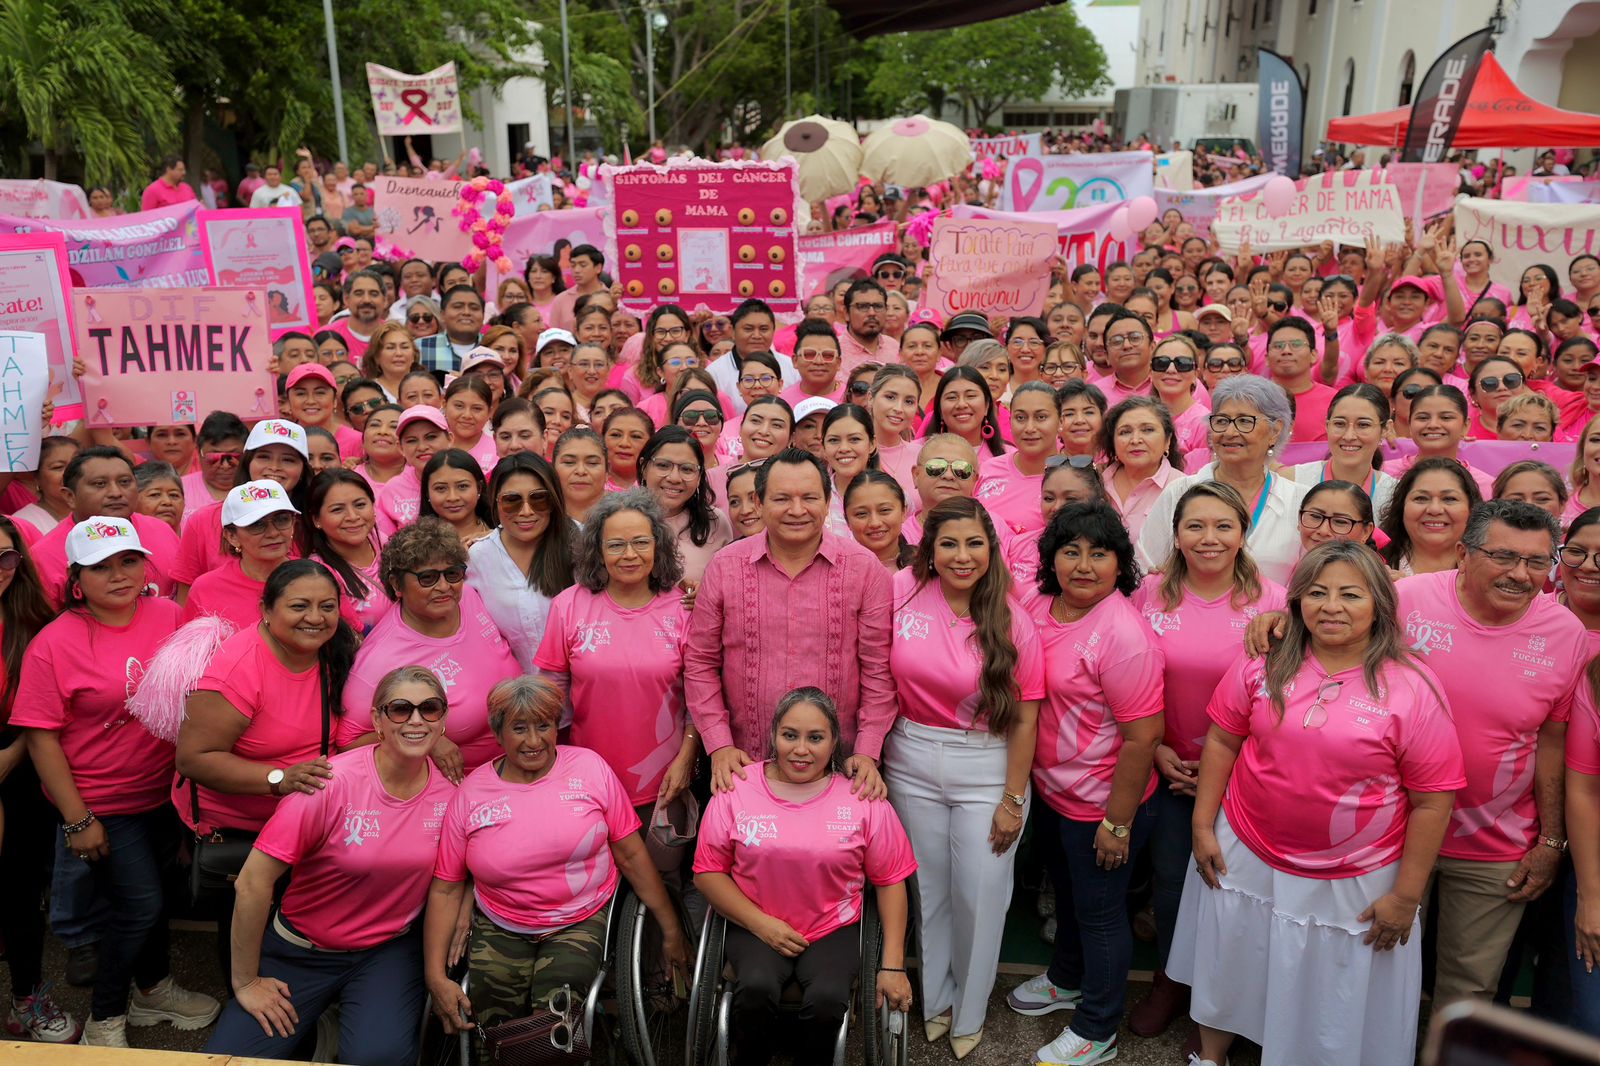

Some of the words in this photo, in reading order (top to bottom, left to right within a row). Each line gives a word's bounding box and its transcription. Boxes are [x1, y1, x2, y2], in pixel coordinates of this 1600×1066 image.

[615, 173, 687, 184] SINTOMAS
[698, 173, 725, 183] DEL
[733, 169, 787, 183] CÁNCER
[699, 189, 719, 199] DE
[1317, 190, 1337, 212] DE
[1346, 189, 1393, 211] MAMA
[685, 205, 729, 216] MAMA
[837, 232, 882, 247] CONTRA
[129, 295, 216, 321] DIF
[88, 324, 253, 376] TAHMEK
[1523, 669, 1537, 678] DIF
[1357, 715, 1370, 725] DIF
[362, 830, 380, 839] 2024
[737, 820, 778, 836] ROSA
